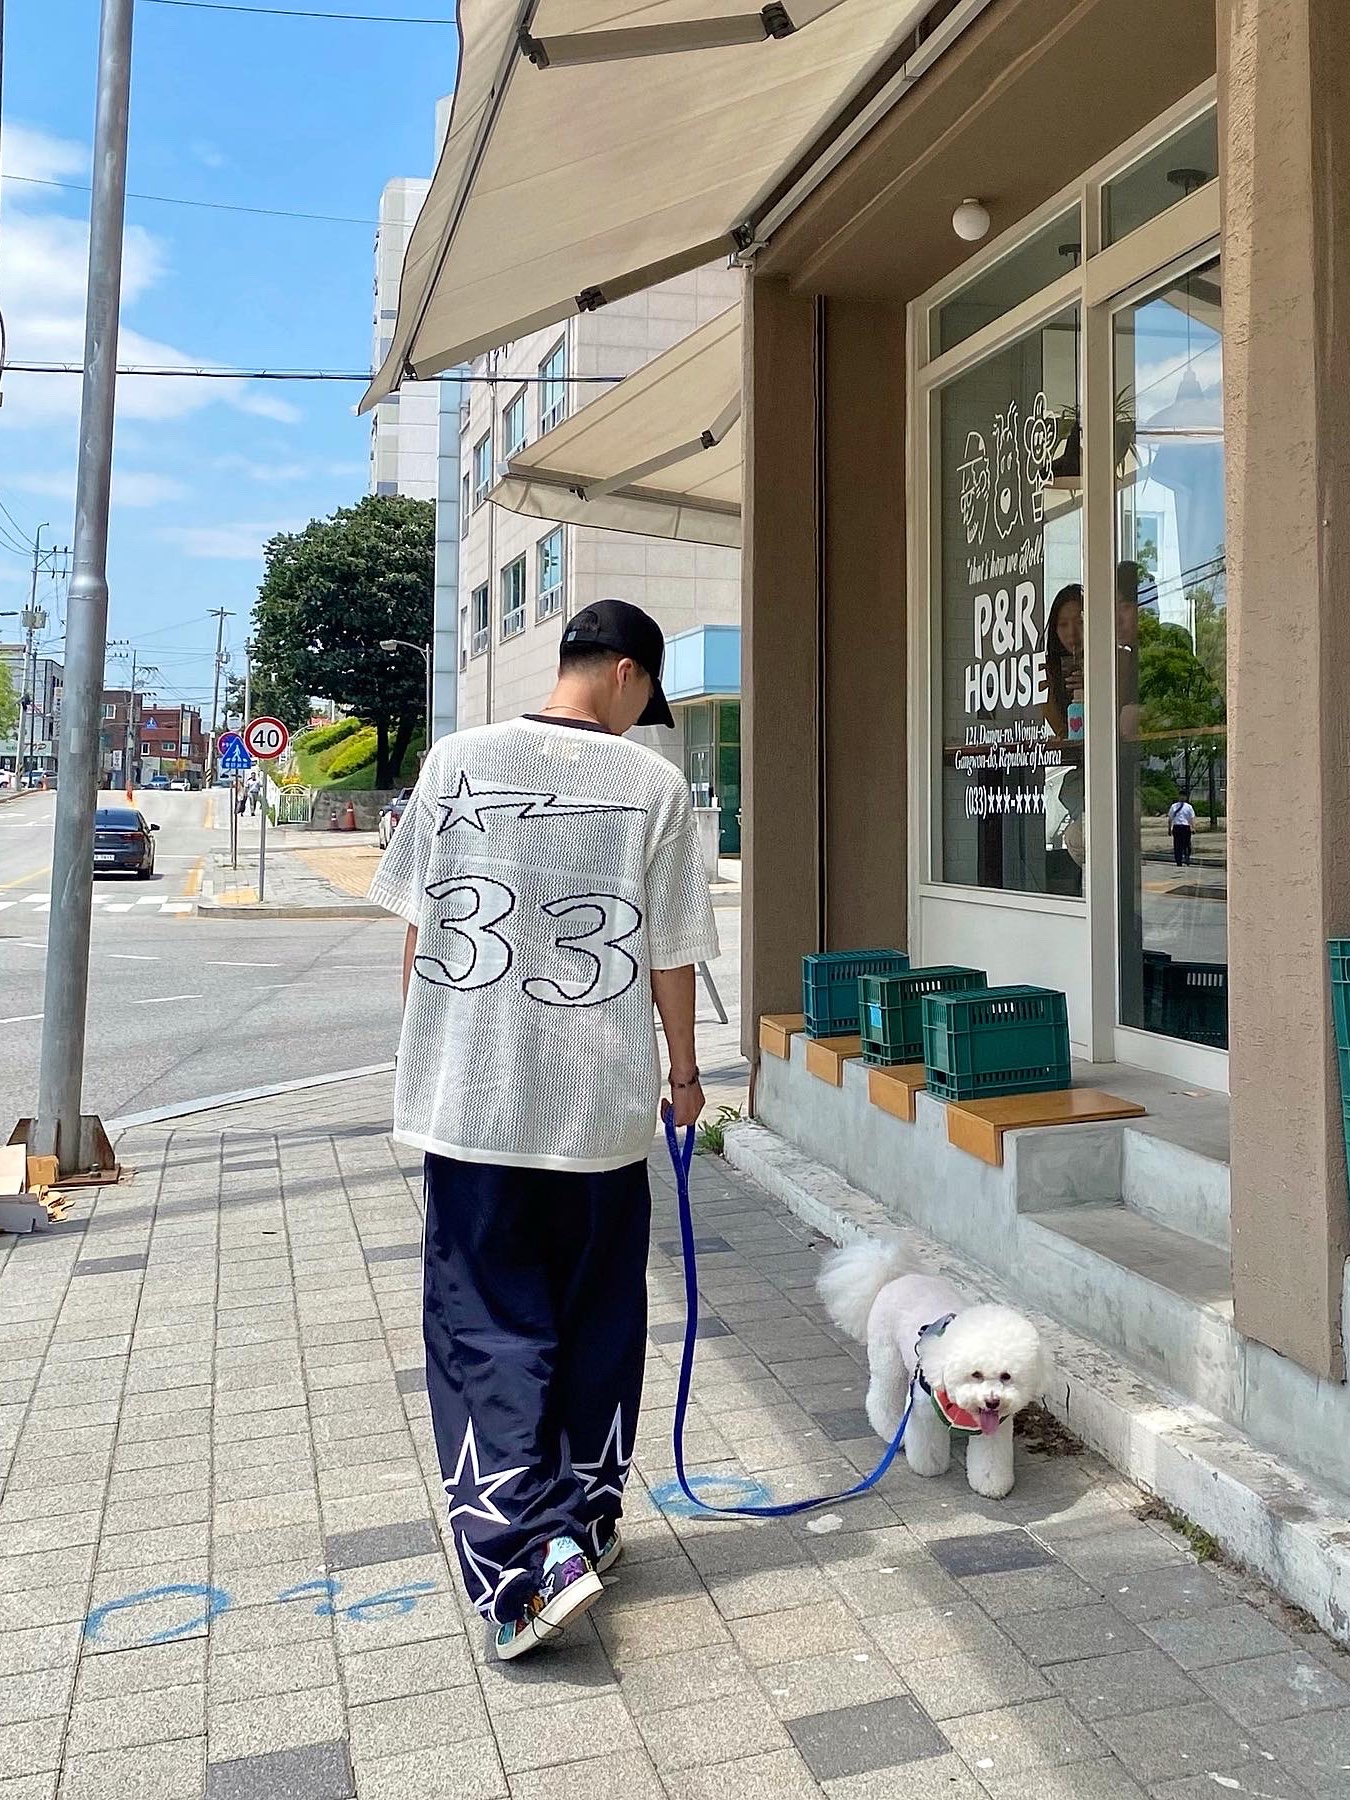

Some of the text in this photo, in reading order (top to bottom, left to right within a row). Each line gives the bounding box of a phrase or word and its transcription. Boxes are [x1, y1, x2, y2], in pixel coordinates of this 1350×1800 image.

[989, 550, 1007, 579] how
[1006, 552, 1019, 574] we
[974, 581, 1039, 660] P&R
[964, 651, 1049, 714] HOUSE
[252, 729, 280, 748] 40
[998, 744, 1029, 775] Republic
[1029, 743, 1039, 774] of
[1037, 744, 1063, 767] Korea
